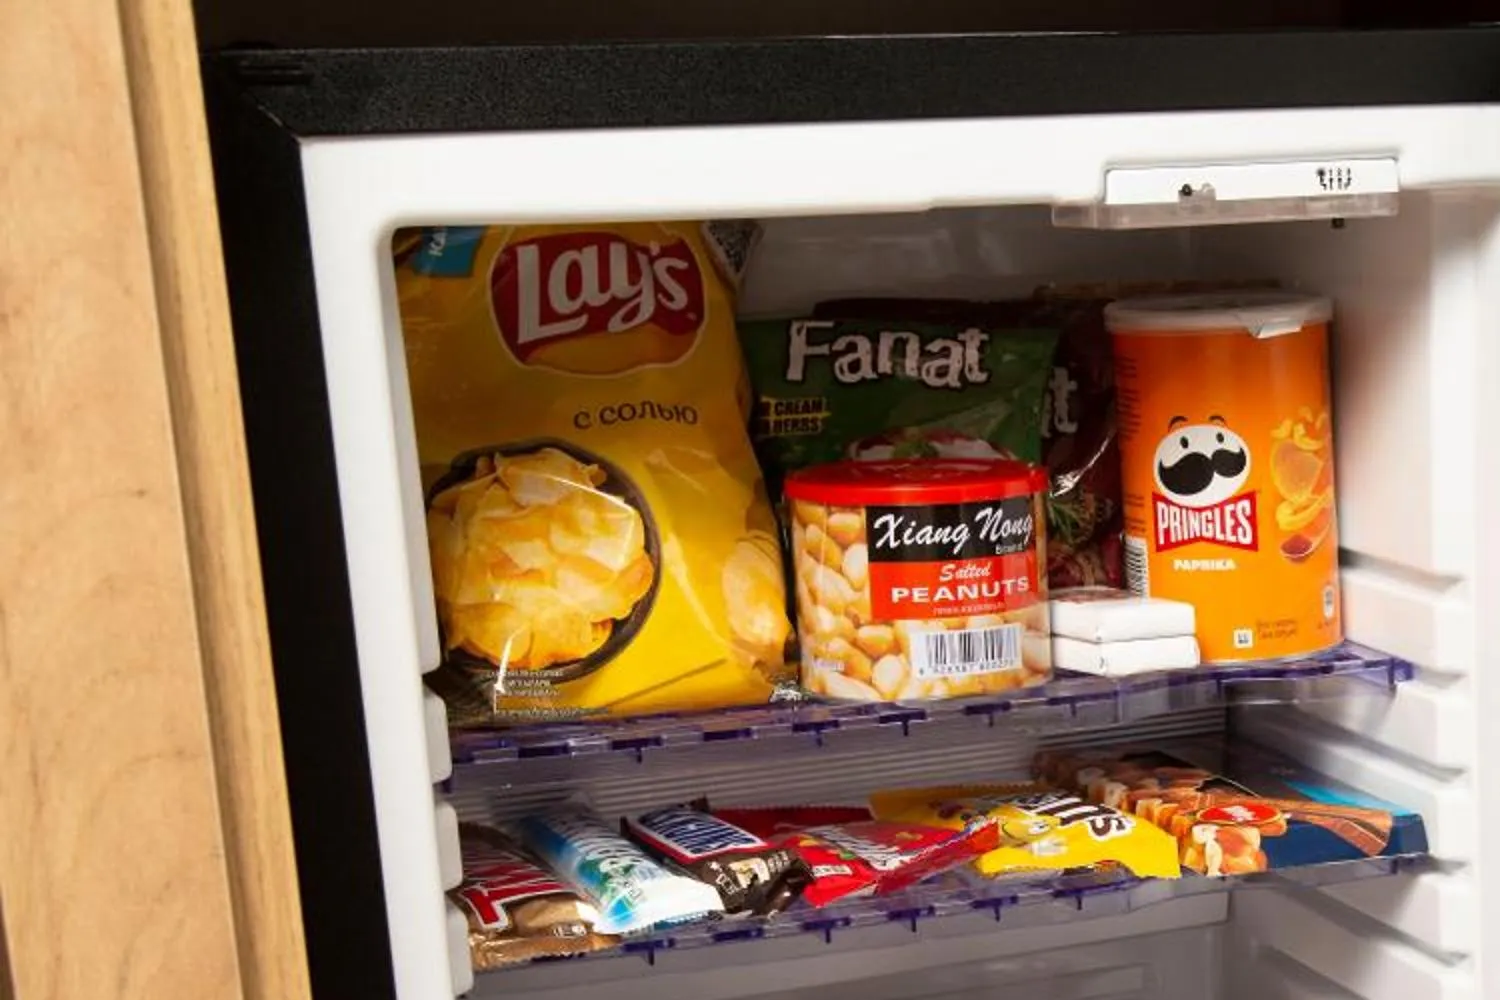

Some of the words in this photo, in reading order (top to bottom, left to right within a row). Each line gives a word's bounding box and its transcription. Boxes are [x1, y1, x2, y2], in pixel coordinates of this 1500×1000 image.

[517, 233, 690, 344] Lay's
[786, 319, 990, 389] Fanat
[873, 512, 971, 555] Xiang
[974, 506, 1034, 545] Nong
[1156, 498, 1253, 546] PRINGLES
[939, 561, 994, 582] Salted
[1172, 558, 1238, 572] PAPRIKA
[890, 576, 1030, 604] PEANUTS
